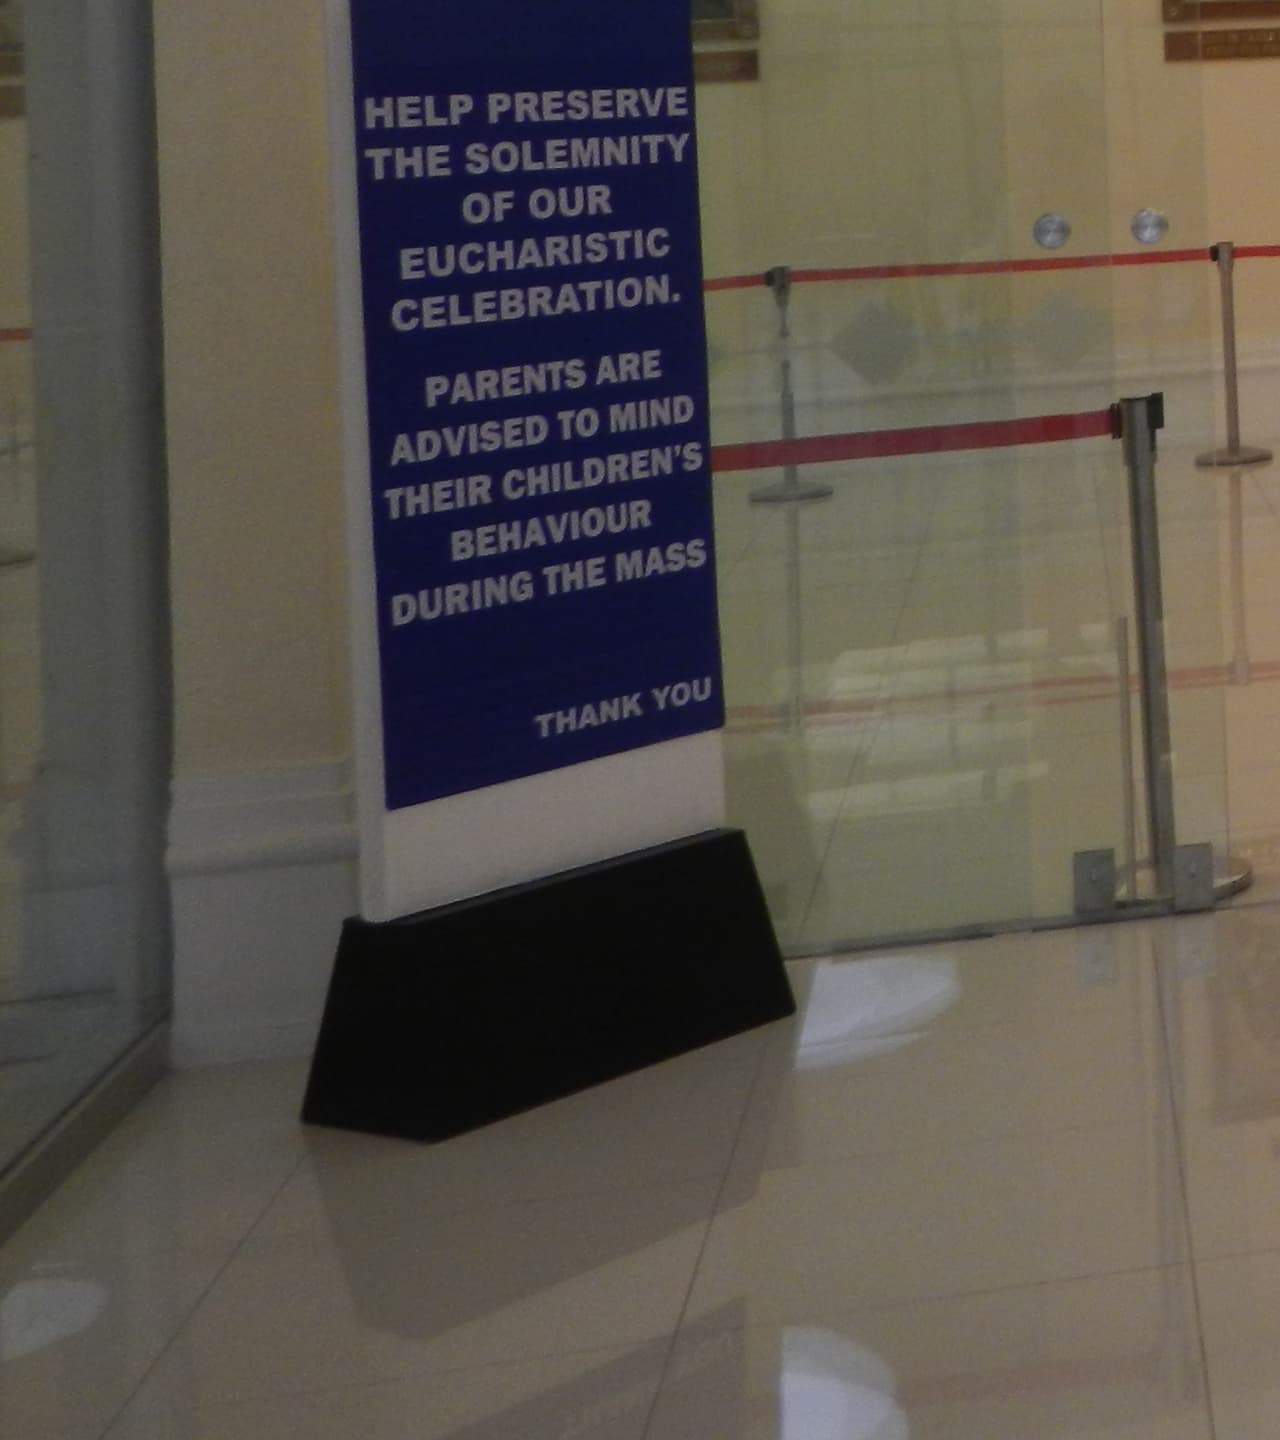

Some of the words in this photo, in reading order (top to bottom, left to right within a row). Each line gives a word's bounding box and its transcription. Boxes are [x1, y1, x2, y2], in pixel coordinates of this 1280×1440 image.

[365, 95, 473, 128] HELP
[488, 87, 688, 123] PRESERVE
[365, 145, 451, 179] THE
[466, 133, 689, 174] SOLEMNITY
[463, 191, 514, 224] OF
[529, 185, 612, 219] OUR
[400, 228, 671, 281] EUCHARISTIC
[392, 274, 680, 331] CELEBRATION.
[426, 359, 587, 407] PARENTS
[596, 350, 661, 385] ARE
[391, 415, 548, 465] ADVISED
[558, 408, 599, 440] TO
[610, 395, 694, 432] MIND
[384, 475, 491, 519] THEIR
[502, 442, 703, 500] CHILDREN'S
[451, 500, 652, 561] BEHAVIOUR
[392, 571, 533, 626] DURING
[542, 557, 606, 595] THE
[616, 539, 706, 581] MASS
[535, 693, 642, 737] THANK
[652, 677, 711, 710] YOU
